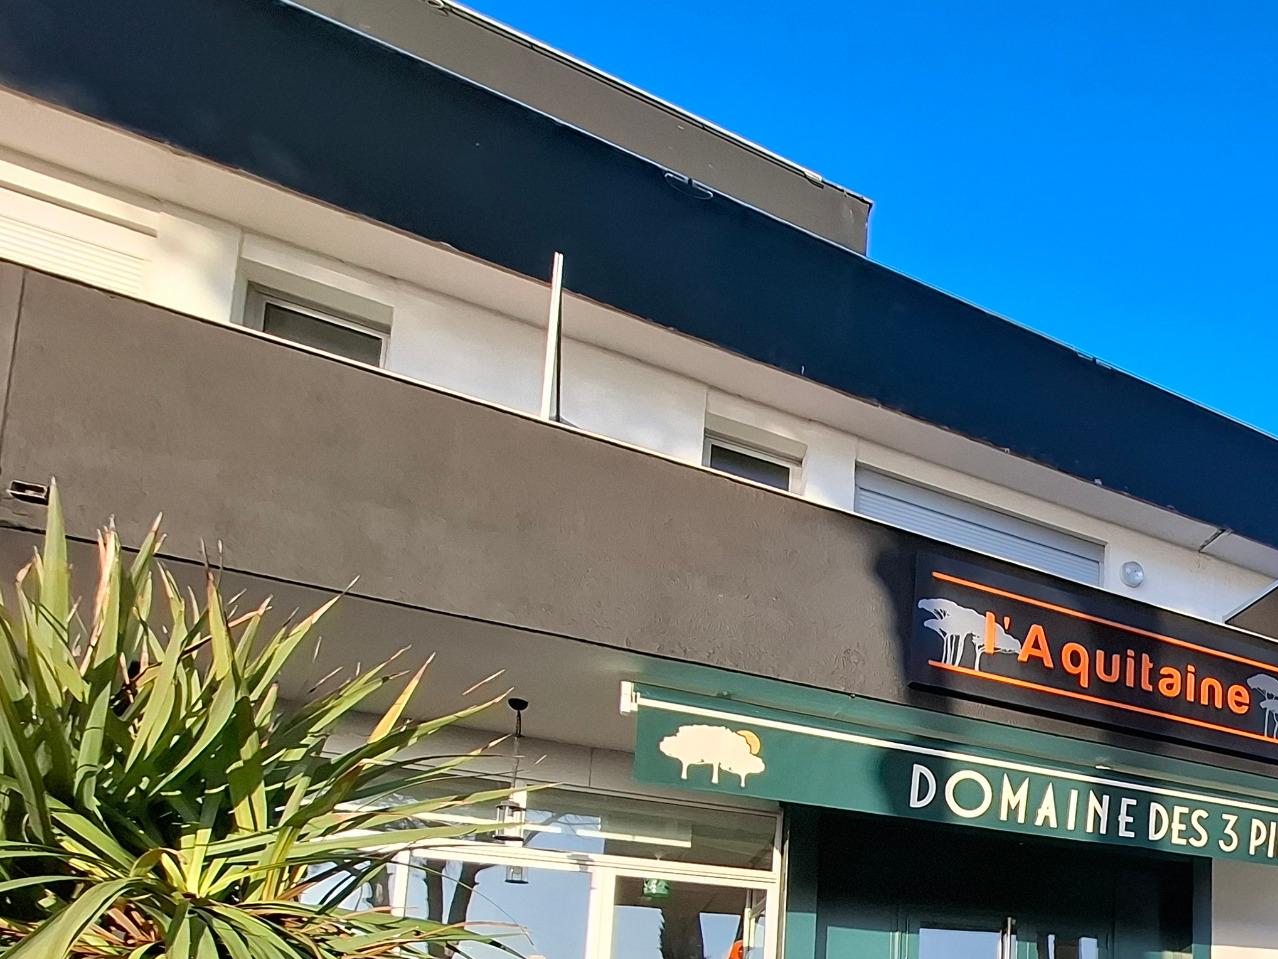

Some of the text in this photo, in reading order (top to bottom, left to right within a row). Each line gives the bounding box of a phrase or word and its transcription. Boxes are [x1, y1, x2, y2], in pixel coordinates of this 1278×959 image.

[984, 611, 1250, 715] l'Aquitaine
[909, 763, 1137, 838] DOMAINE
[1148, 801, 1208, 848] DES
[1218, 813, 1240, 853] 3
